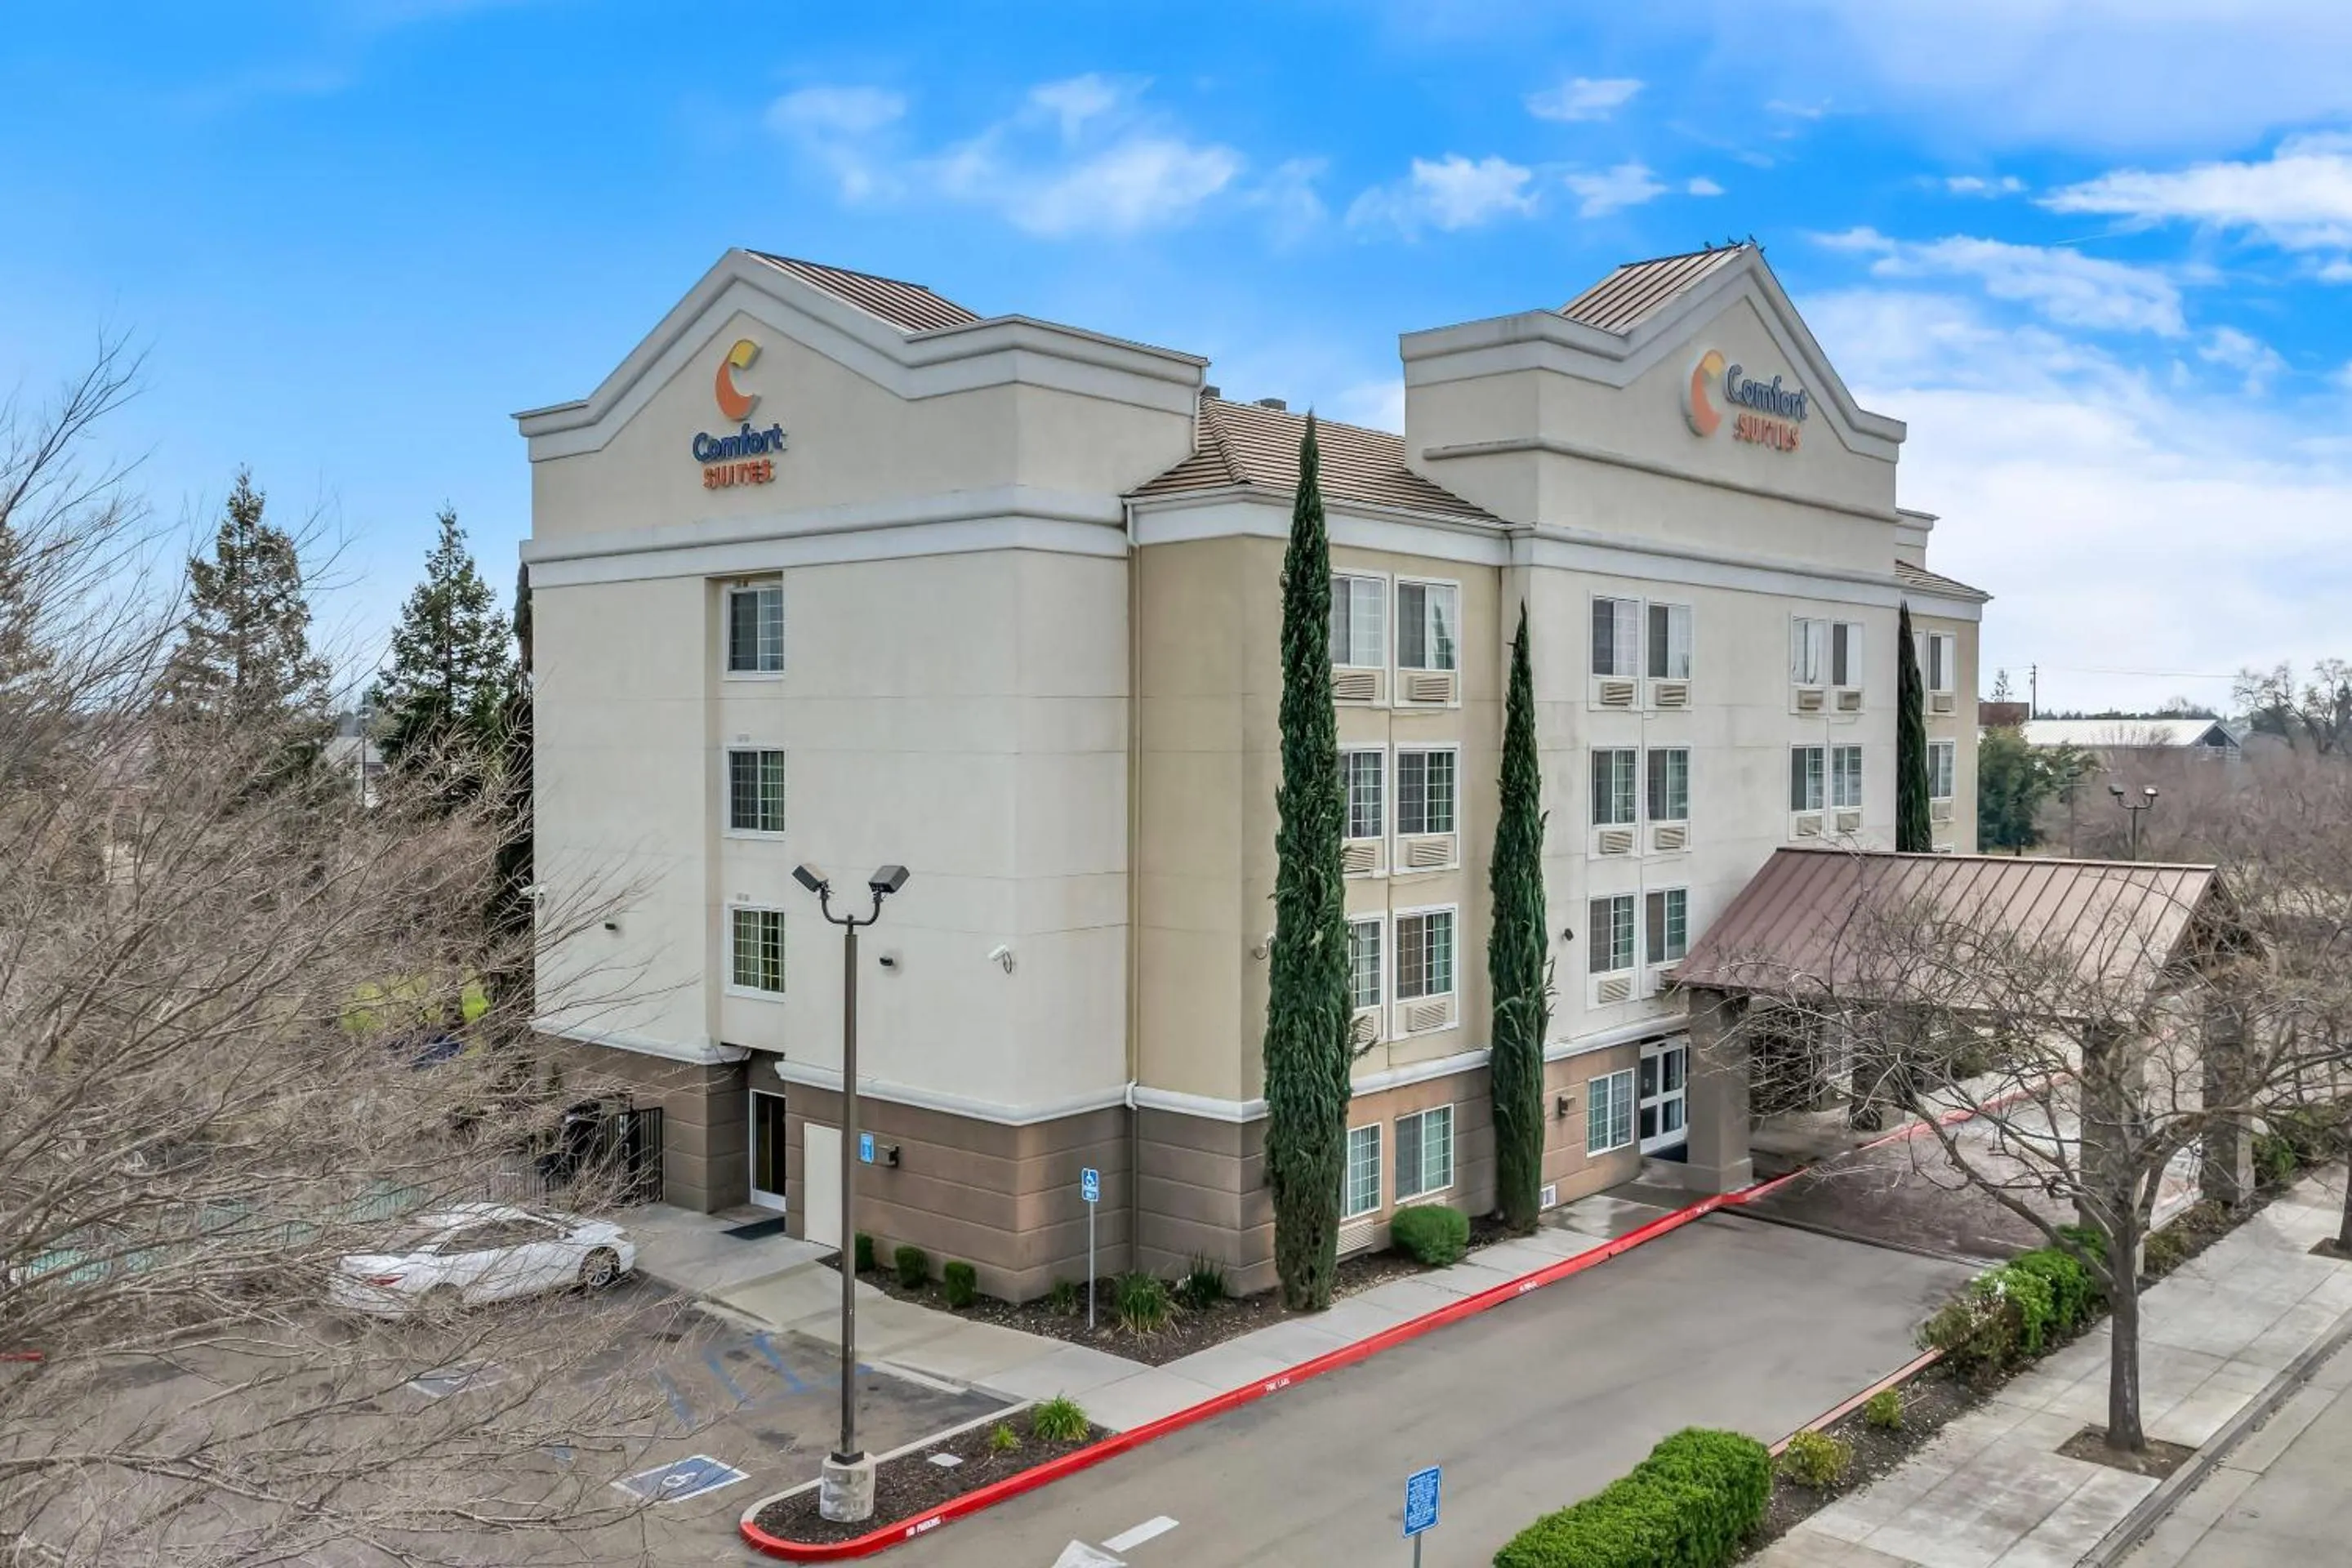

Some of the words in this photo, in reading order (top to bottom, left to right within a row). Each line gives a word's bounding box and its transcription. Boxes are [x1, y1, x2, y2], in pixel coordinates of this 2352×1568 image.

[1724, 364, 1807, 421] Comfort
[693, 422, 786, 462] Comfort
[1733, 412, 1802, 452] SUITES
[702, 459, 775, 489] SUITES
